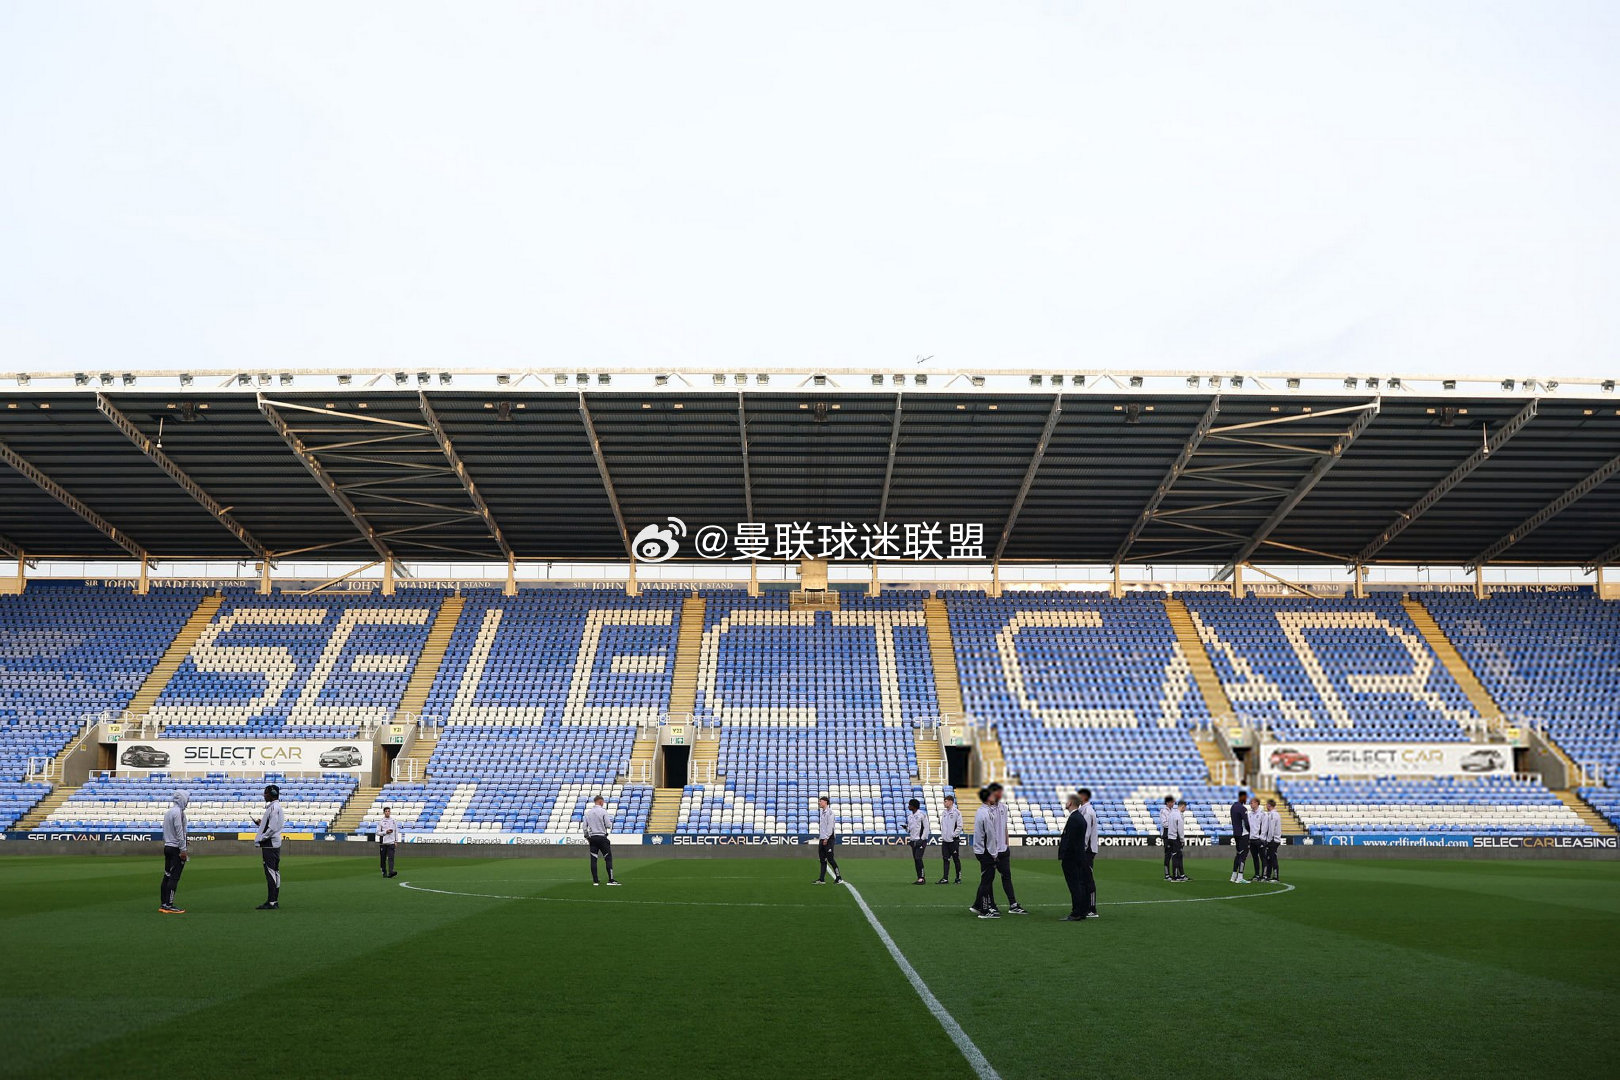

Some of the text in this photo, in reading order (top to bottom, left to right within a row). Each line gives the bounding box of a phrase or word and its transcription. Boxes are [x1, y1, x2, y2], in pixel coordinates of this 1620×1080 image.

[348, 582, 379, 590] JOHN
[184, 746, 302, 759] SELECT CAR
[1326, 750, 1443, 763] SELECT CAR
[673, 836, 799, 846] SELECTCARLEASING
[1098, 837, 1147, 846] PORTFIVE
[1362, 837, 1469, 848] www.crlfireflood.com
[1473, 837, 1616, 848] SELECTCARLEASING
